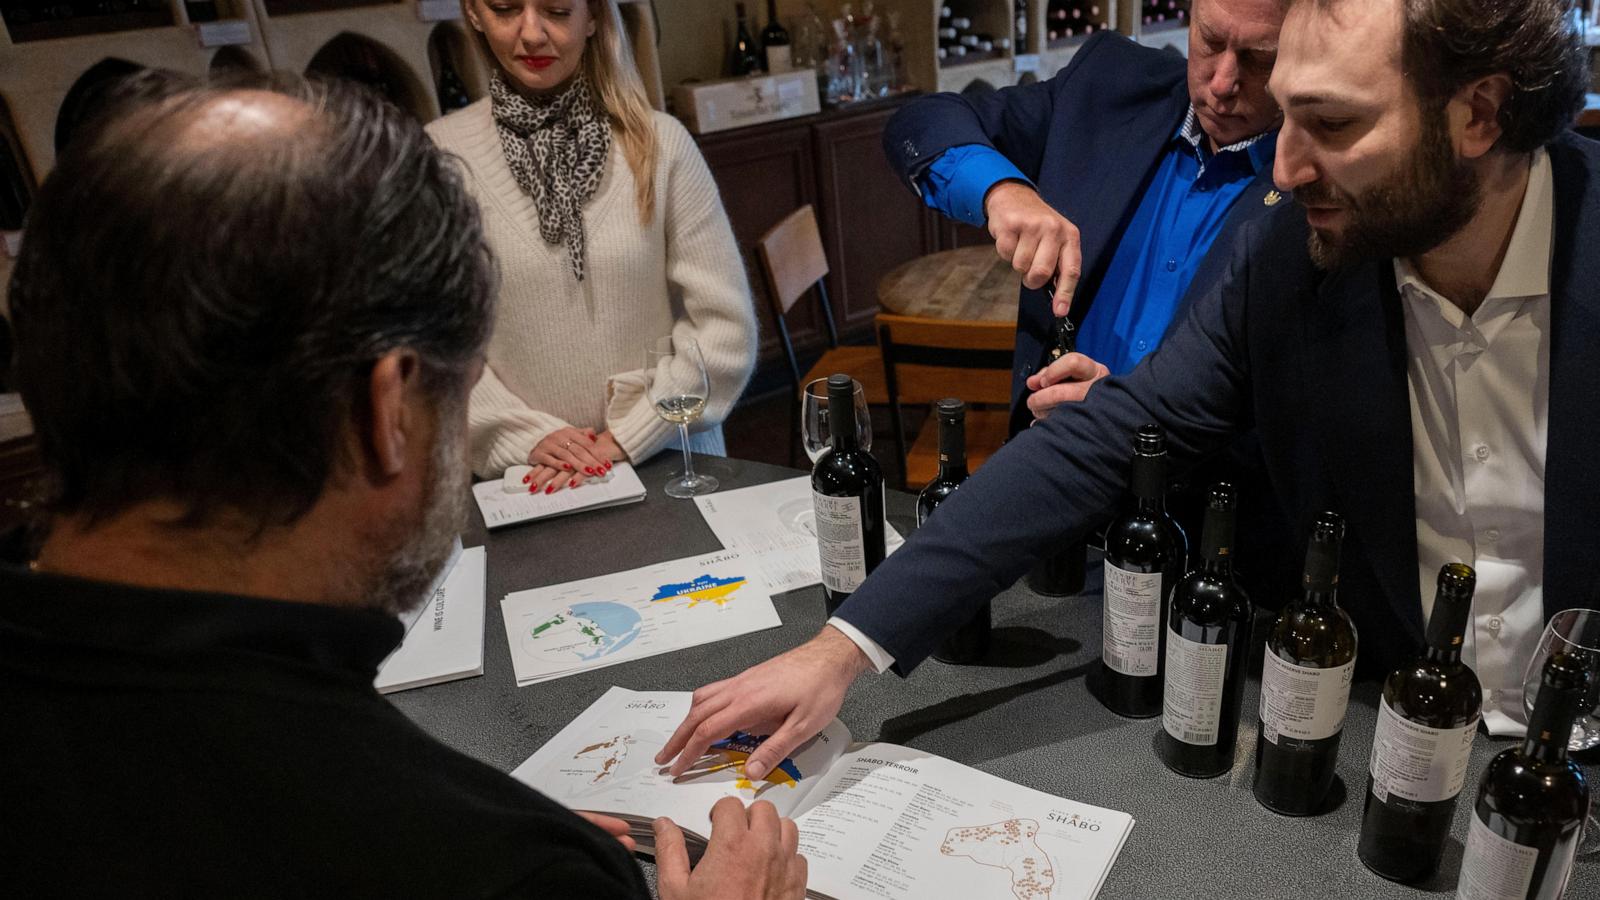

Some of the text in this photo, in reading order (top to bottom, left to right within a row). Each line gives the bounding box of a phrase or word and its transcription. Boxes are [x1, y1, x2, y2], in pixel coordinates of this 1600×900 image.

[676, 582, 717, 595] UKRAINE
[435, 587, 446, 611] CULTURE
[433, 617, 444, 632] WINE
[727, 742, 755, 754] UKRA
[856, 757, 919, 774] SHABO TERROIR
[1047, 812, 1100, 831] SHABO
